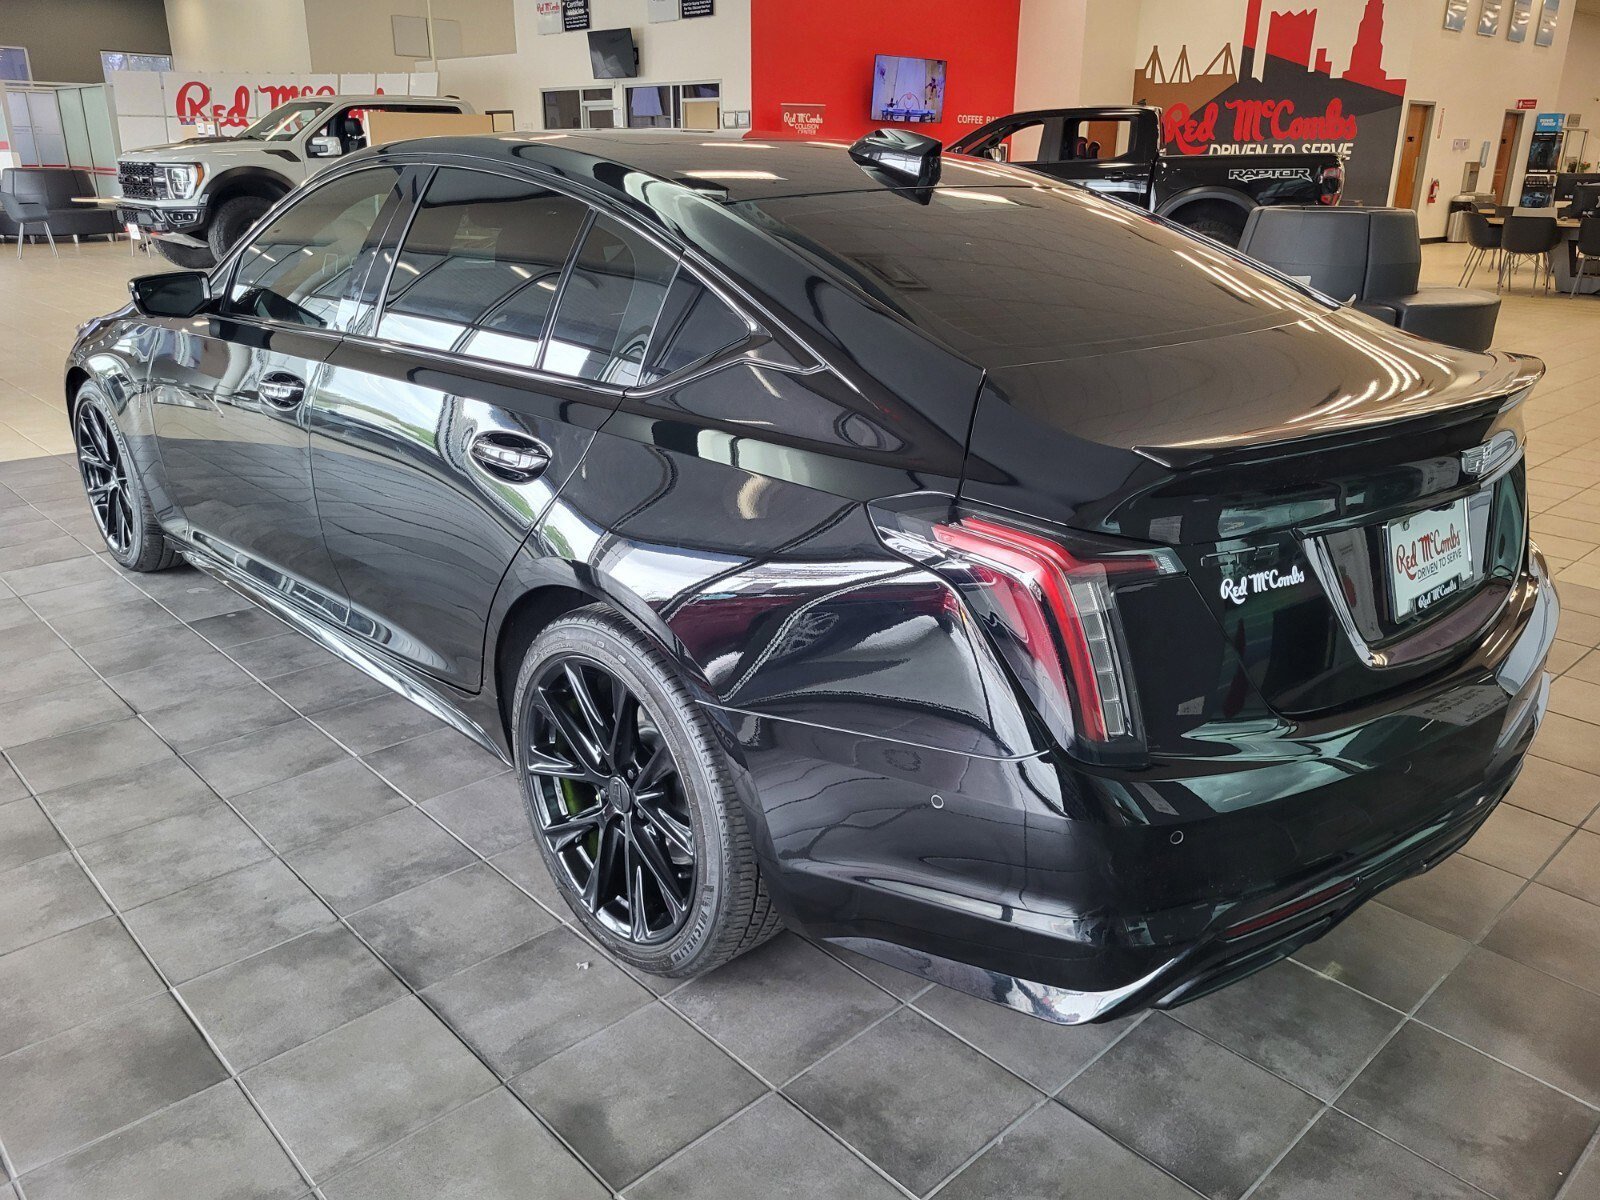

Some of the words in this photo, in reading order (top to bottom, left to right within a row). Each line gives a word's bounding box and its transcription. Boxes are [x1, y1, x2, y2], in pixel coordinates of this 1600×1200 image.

[175, 81, 250, 127] Red
[784, 112, 796, 126] Red
[957, 115, 984, 124] COFFEE
[1164, 102, 1219, 155] Red
[1225, 97, 1358, 141] McCombs
[1228, 168, 1314, 183] RAPTOR
[1396, 541, 1419, 580] Red
[1417, 522, 1461, 563] McCombs
[1417, 561, 1438, 580] DRIVEN
[1438, 558, 1446, 568] TO
[1447, 548, 1462, 564] SERVE
[1220, 578, 1248, 605] Red
[1248, 565, 1305, 593] McCombs
[1418, 594, 1431, 609] Red
[1431, 579, 1457, 601] McCombs
[673, 910, 709, 963] MICHELIN
